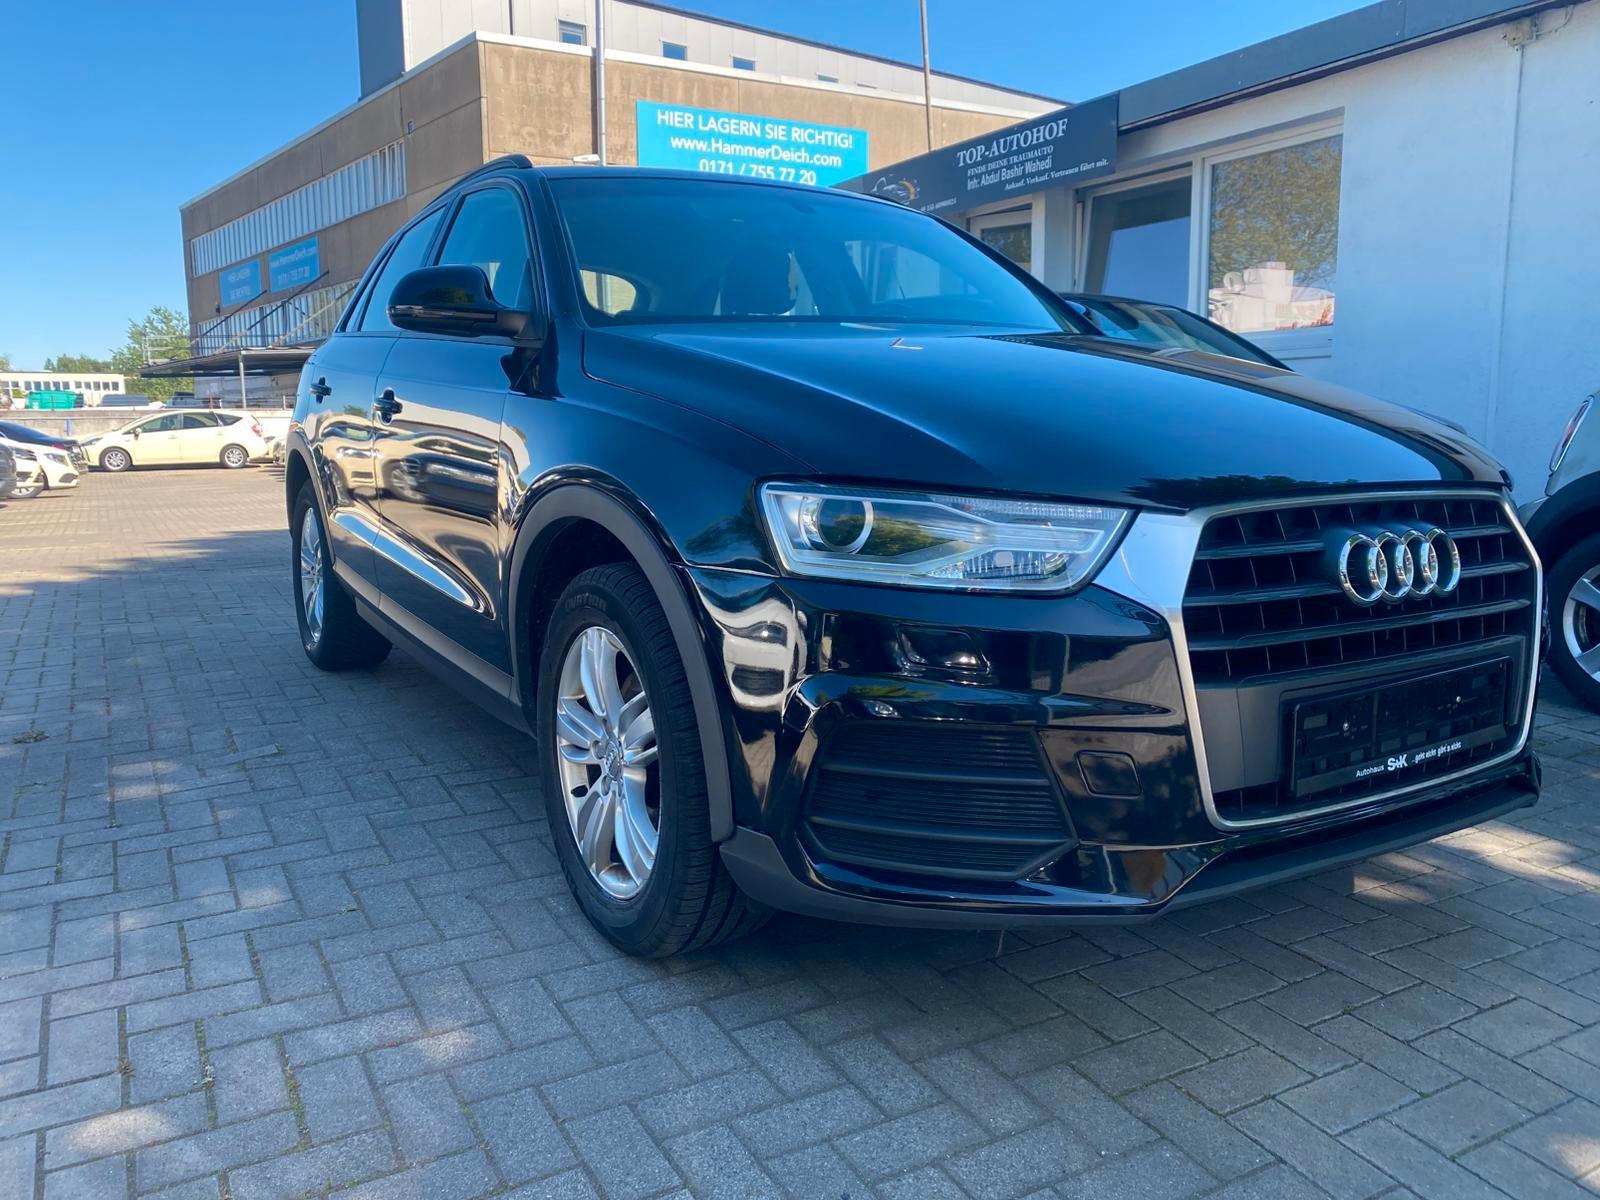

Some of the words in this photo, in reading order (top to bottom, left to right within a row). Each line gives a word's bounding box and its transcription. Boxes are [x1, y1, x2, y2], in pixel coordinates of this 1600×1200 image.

[657, 109, 694, 128] HIER
[698, 115, 761, 137] LAGERN
[765, 123, 787, 140] SIE
[791, 127, 853, 149] RICHTIG!
[956, 118, 1068, 167] TOP-AUTOHOF
[670, 135, 842, 167] www.HammerDeich.com
[967, 164, 987, 177] FINDE
[987, 158, 1008, 171] DEINE
[1009, 144, 1054, 164] TRAUMAUTO
[699, 158, 733, 175] 0171
[739, 163, 746, 176] /
[749, 164, 775, 179] 755
[778, 167, 796, 182] 77
[799, 170, 817, 185] 20
[967, 177, 980, 191] Inh:
[980, 171, 1000, 188] Abdul
[1001, 165, 1024, 181] Bashir
[1025, 156, 1052, 174] Wahedi
[1355, 764, 1385, 778] Autohaus
